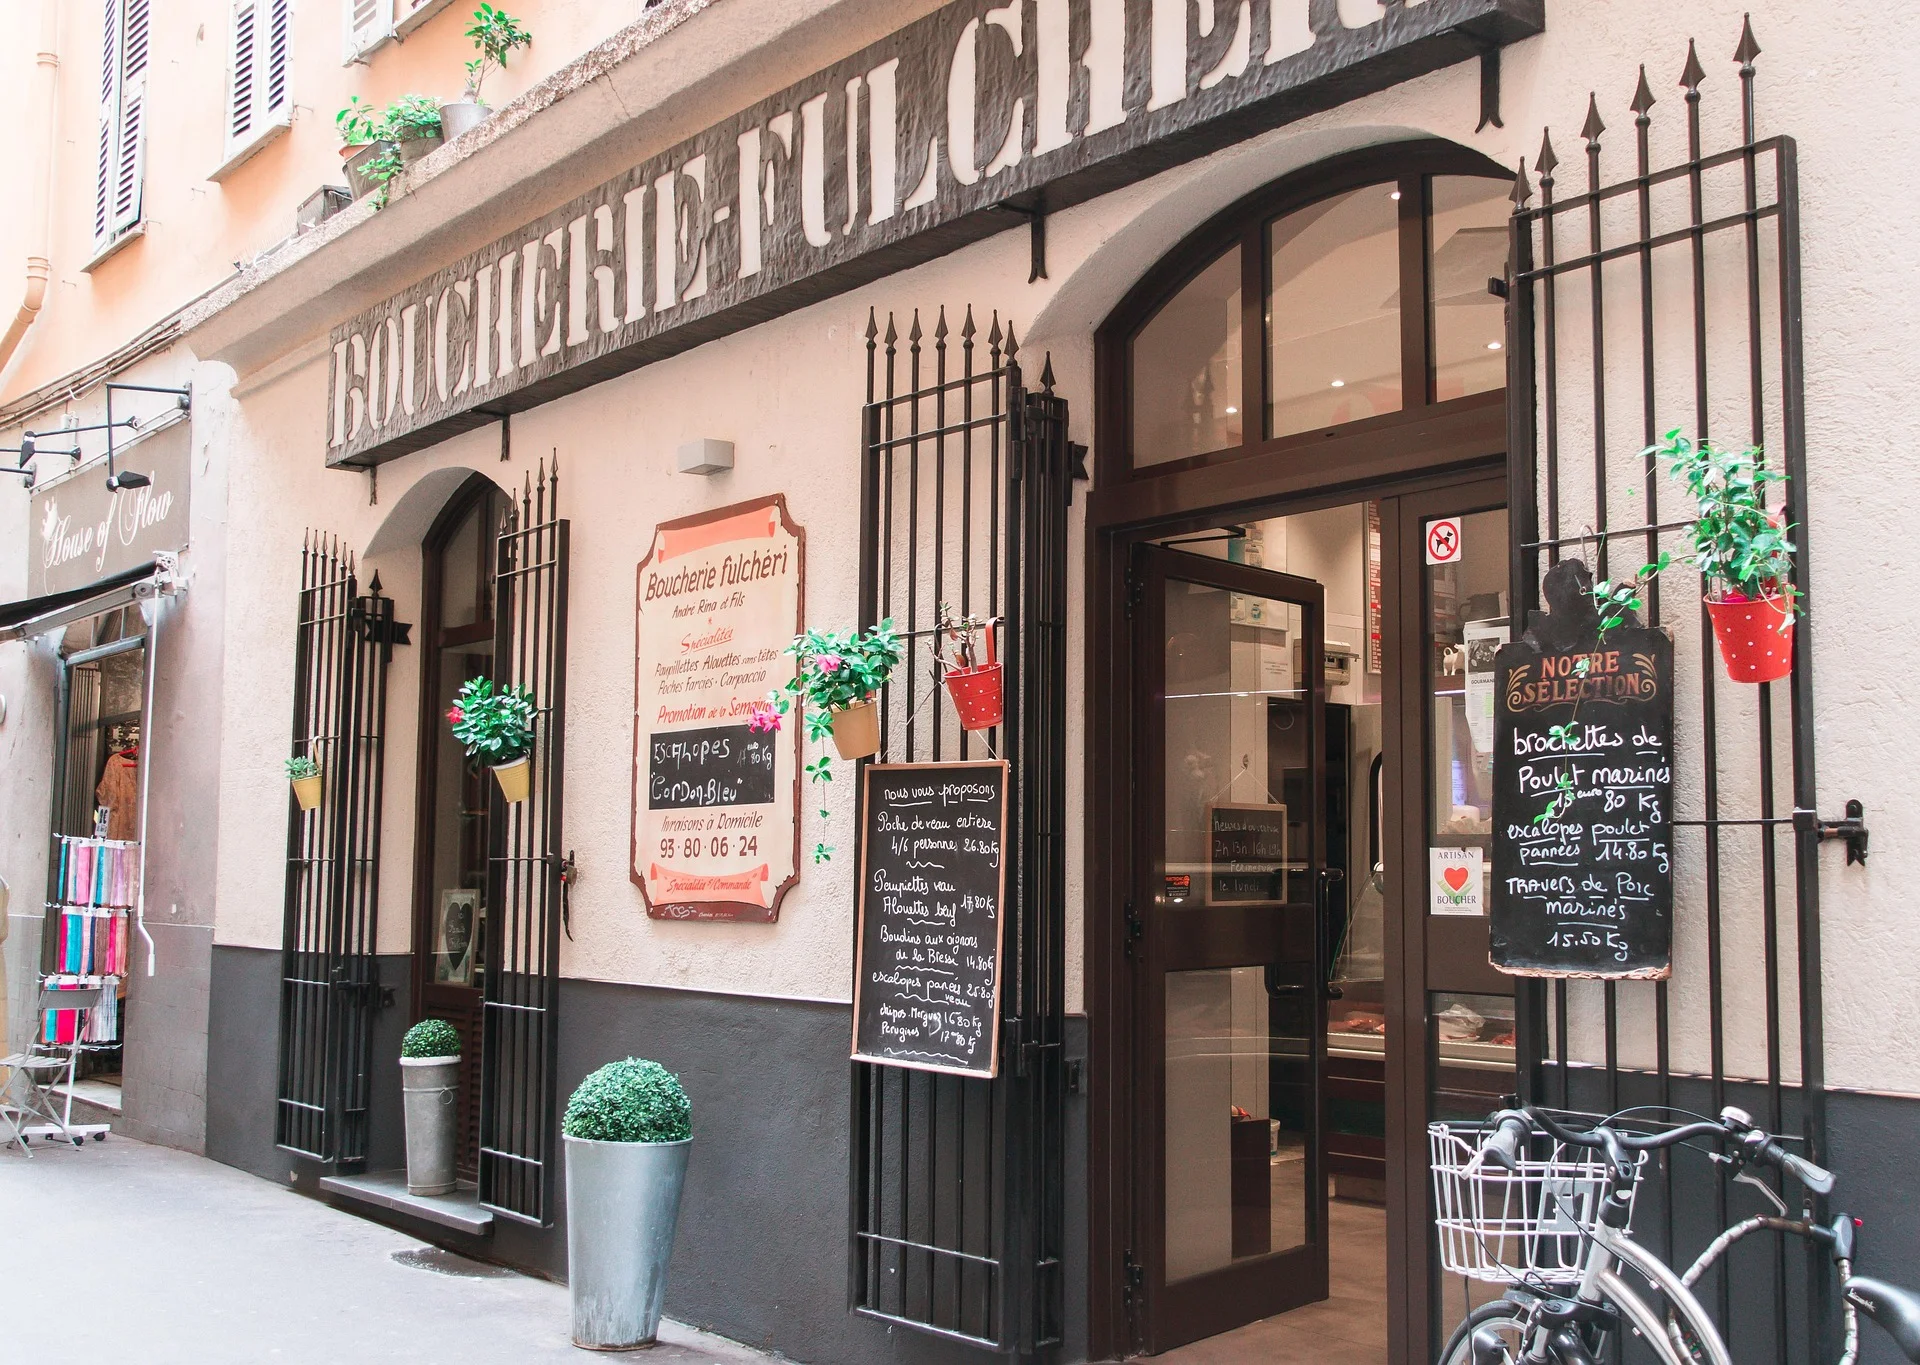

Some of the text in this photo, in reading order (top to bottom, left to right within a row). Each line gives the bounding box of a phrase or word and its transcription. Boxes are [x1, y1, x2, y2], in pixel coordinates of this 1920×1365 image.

[96, 493, 117, 573] of
[119, 470, 175, 546] Flow
[644, 561, 717, 602] Boucherie
[671, 602, 696, 619] André
[720, 597, 730, 610] et
[730, 591, 746, 609] Fils
[702, 652, 742, 671] Alouettes
[741, 656, 758, 665] sans
[1541, 651, 1620, 679] NOTRE
[720, 667, 767, 690] Carpaccio
[657, 703, 707, 725] Promotion
[708, 706, 718, 719] de
[719, 705, 727, 718] la
[1513, 724, 1663, 756] brochettes de
[1518, 763, 1585, 794] Poult
[884, 783, 996, 807] nous vous proposons
[1603, 792, 1626, 813] 80
[1638, 792, 1663, 823] Kg
[716, 811, 764, 831] Domicile
[877, 811, 909, 832] Poche
[911, 815, 924, 830] de
[925, 817, 951, 830] veau
[1507, 817, 1650, 846] escalopes poulet
[660, 835, 758, 858] 93 80 06 24
[891, 836, 909, 856] 4/6
[1437, 851, 1475, 860] ARTISAN
[1595, 842, 1648, 862] 14.80
[933, 880, 956, 893] veau
[1581, 873, 1608, 892] de
[1615, 871, 1655, 897] Porc
[883, 896, 930, 916] Alouettes
[1436, 895, 1477, 905] BOUCHER
[880, 925, 978, 954] Boudins aux oignons
[1546, 931, 1629, 962] 15.50 Kg
[895, 948, 908, 961] de
[912, 948, 925, 962] la
[928, 948, 959, 966] Bresse
[872, 971, 922, 993] escalopes
[945, 993, 972, 1008] veau
